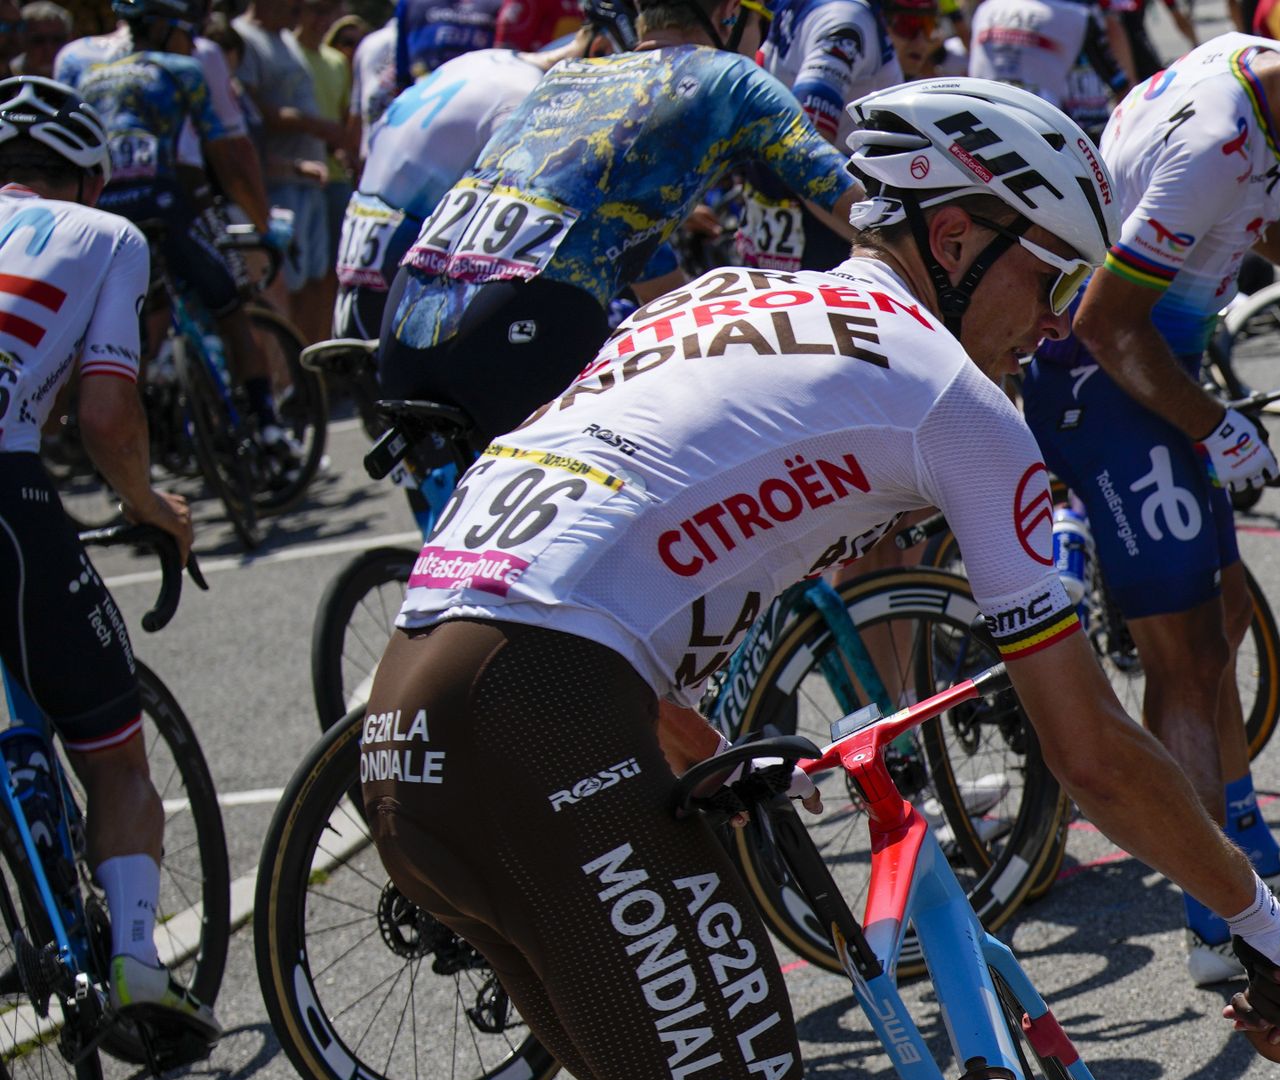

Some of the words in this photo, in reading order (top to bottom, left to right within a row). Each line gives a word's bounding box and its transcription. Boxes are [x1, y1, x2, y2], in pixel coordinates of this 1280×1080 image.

[933, 110, 1065, 210] HJC
[951, 145, 991, 181] #rideforGino
[1076, 137, 1112, 206] CITROËN
[480, 202, 565, 265] 192
[604, 269, 801, 346] G2R
[464, 468, 587, 550] 96
[657, 454, 872, 577] CITROËN
[1096, 469, 1140, 557] TotalEnergies
[394, 709, 430, 742] LA
[360, 749, 446, 785] ONDIALE
[671, 872, 770, 1021] AG2R
